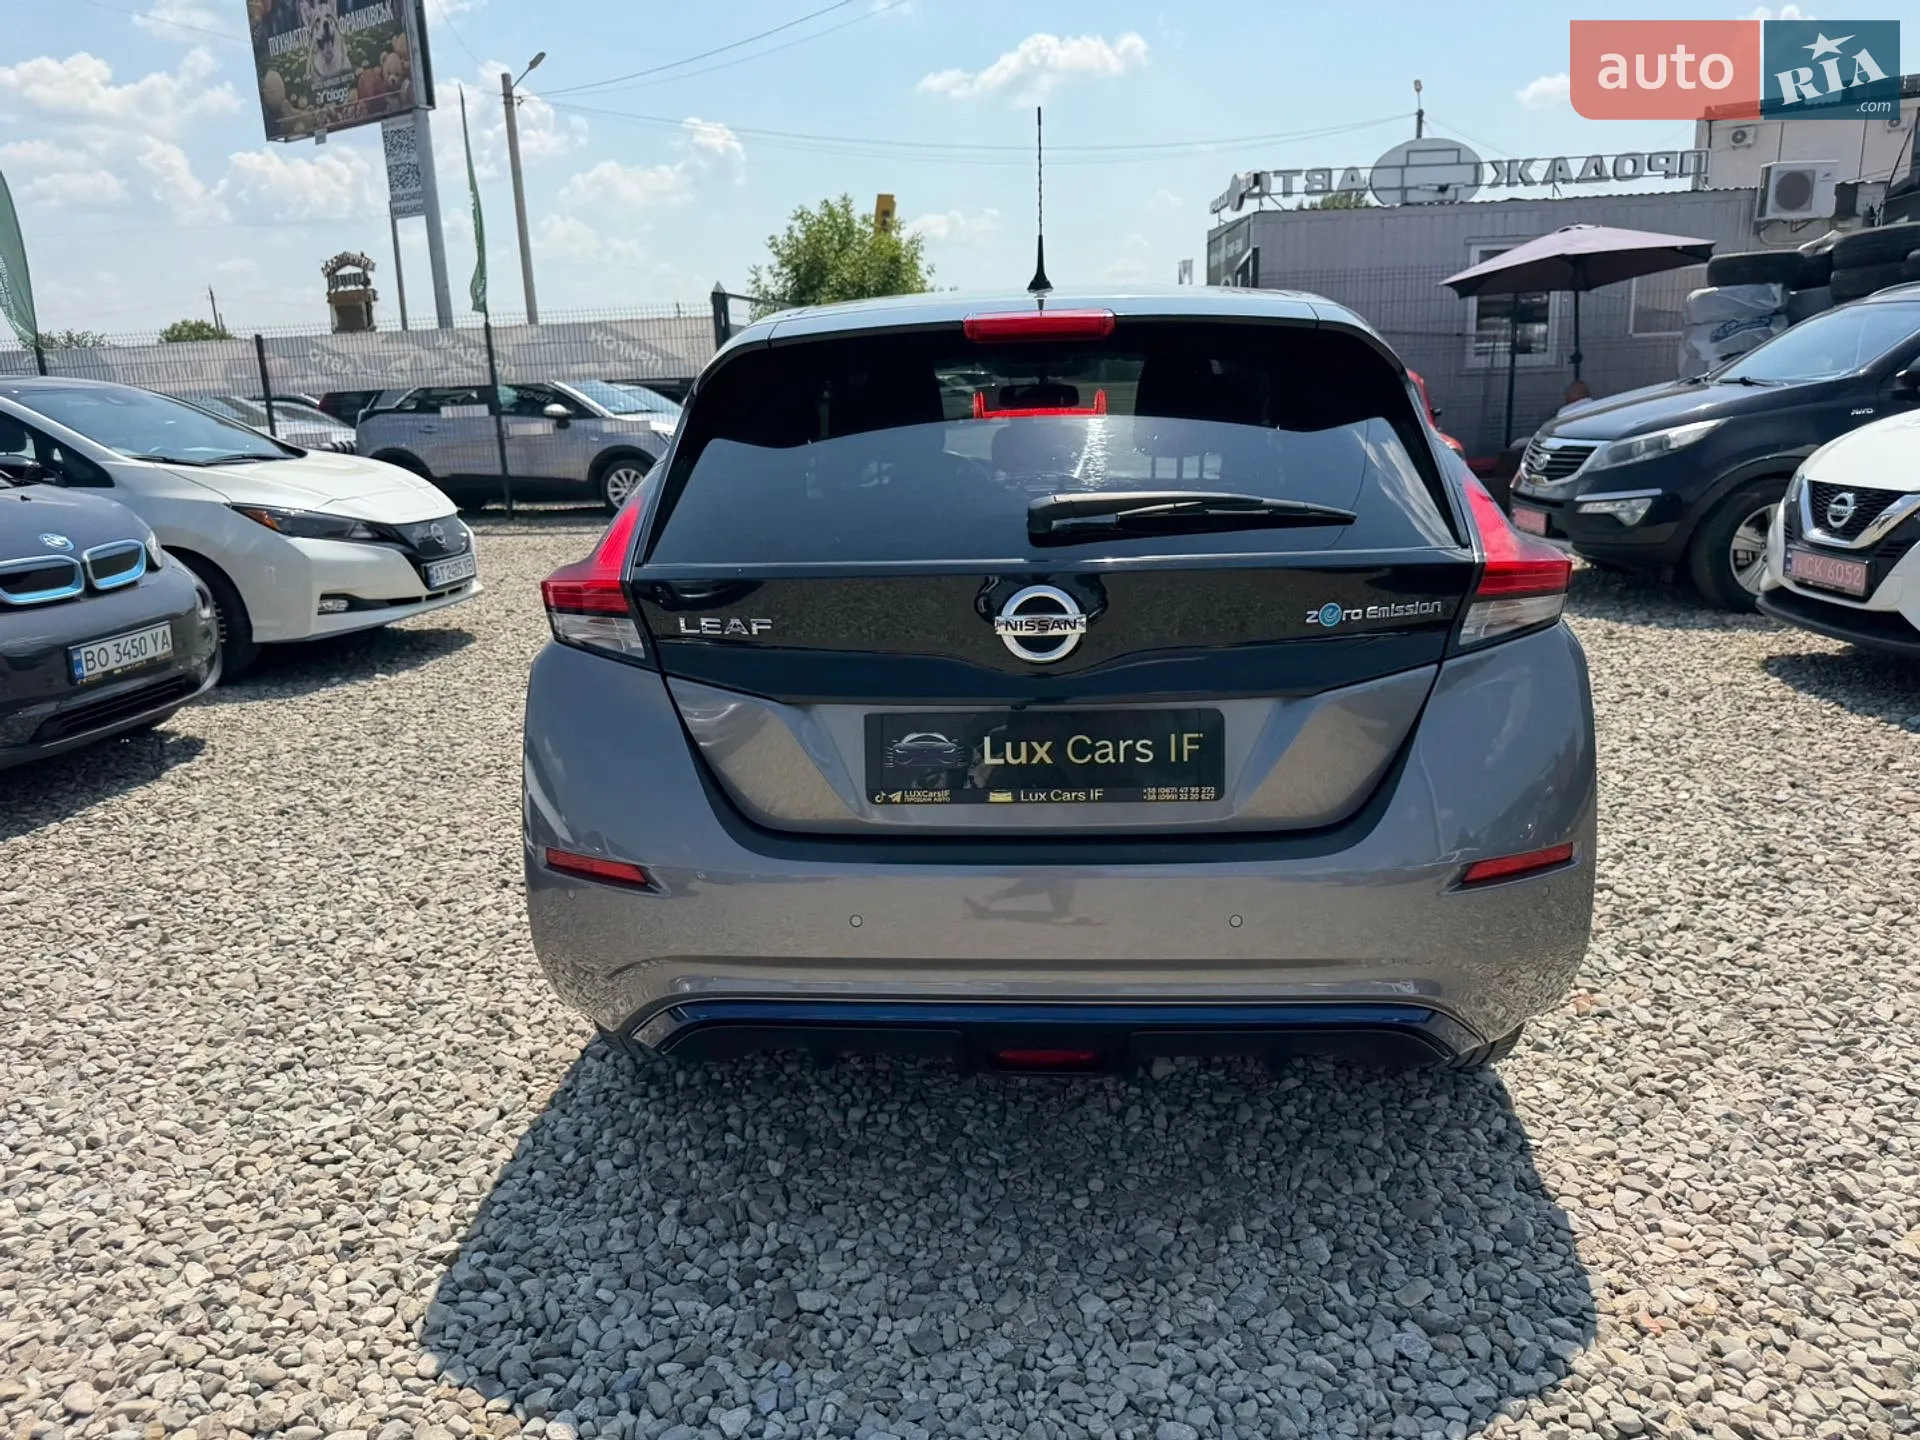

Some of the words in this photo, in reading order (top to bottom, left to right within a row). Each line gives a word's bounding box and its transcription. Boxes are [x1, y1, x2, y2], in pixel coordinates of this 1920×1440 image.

[338, 0, 395, 34] ФРАНКІВСЬК
[1366, 601, 1441, 619] Emission
[679, 617, 773, 635] LEAF
[1005, 619, 1077, 631] NISSAN
[84, 647, 109, 672] BO
[113, 636, 148, 663] 3450
[150, 630, 171, 652] YA
[983, 736, 1053, 765] Lux
[1066, 735, 1154, 764] Cars
[1169, 733, 1204, 762] IF
[1020, 790, 1048, 802] Lux
[1050, 790, 1087, 802] Cars
[1090, 789, 1104, 801] IF
